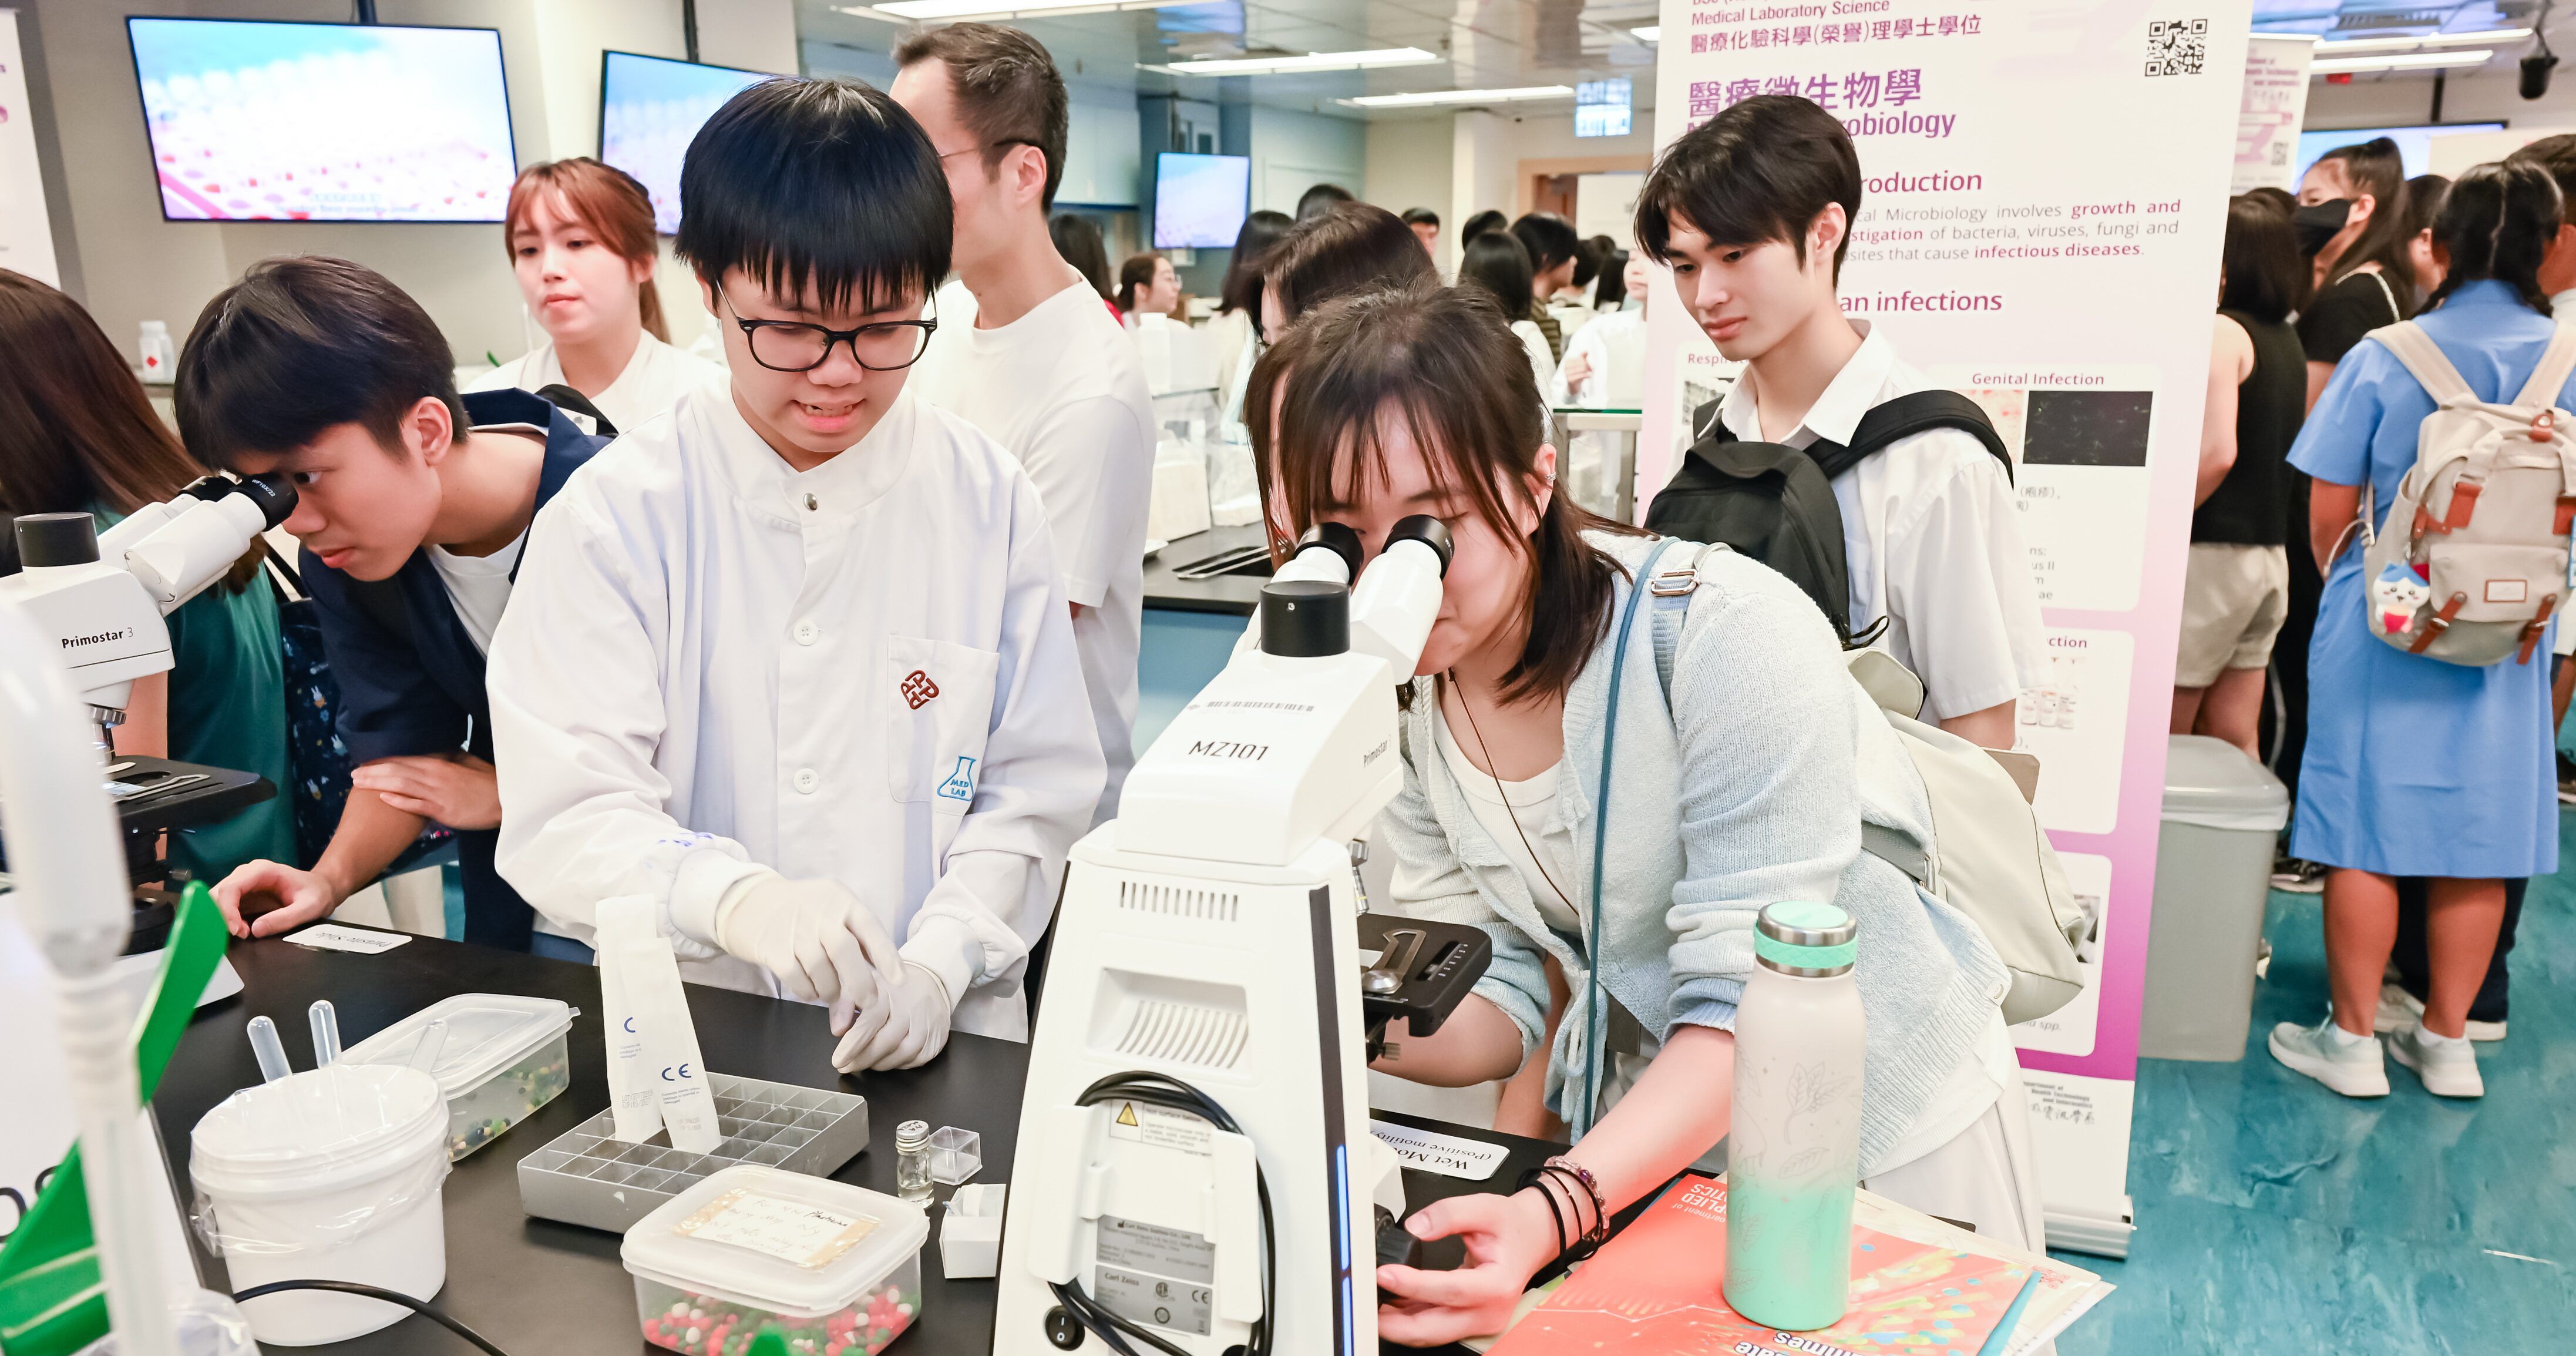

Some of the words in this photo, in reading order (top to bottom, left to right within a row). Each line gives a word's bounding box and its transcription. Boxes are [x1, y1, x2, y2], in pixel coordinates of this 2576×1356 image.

[1692, 11, 1745, 25] Medical
[1750, 5, 1826, 21] Laboratory
[1832, 0, 1889, 15] Science
[1691, 14, 1982, 53] 醫療化驗科學(榮譽)理學士學位
[1886, 206, 1988, 224] Microbiology
[1997, 203, 2062, 219] involves
[2071, 200, 2136, 220] growth
[2147, 199, 2181, 213] and
[1931, 226, 1947, 240] of
[1953, 224, 2020, 240] bacteria,
[2027, 223, 2089, 238] viruses,
[2097, 220, 2140, 239] fungi
[2147, 220, 2180, 235] and
[1889, 247, 1919, 260] that
[1925, 248, 1969, 260] cause
[1975, 244, 2060, 259] infectious
[2065, 243, 2144, 257] diseases.
[1876, 290, 2002, 312] infections
[1972, 372, 2027, 385] Genital
[2033, 372, 2104, 385] Infection
[62, 630, 123, 649] Primostar
[127, 626, 134, 638] 3
[1188, 740, 1269, 761] MZ101
[950, 778, 969, 788] MED
[950, 787, 966, 797] LAB
[661, 1063, 692, 1082] CE
[1394, 1147, 1429, 1163] Mo
[1430, 1144, 1492, 1161] (Positive
[1435, 1156, 1467, 1170] Wet
[1690, 1184, 1727, 1203] TICS
[1681, 1193, 1727, 1215] PLIED
[1104, 1273, 1119, 1281] Carl
